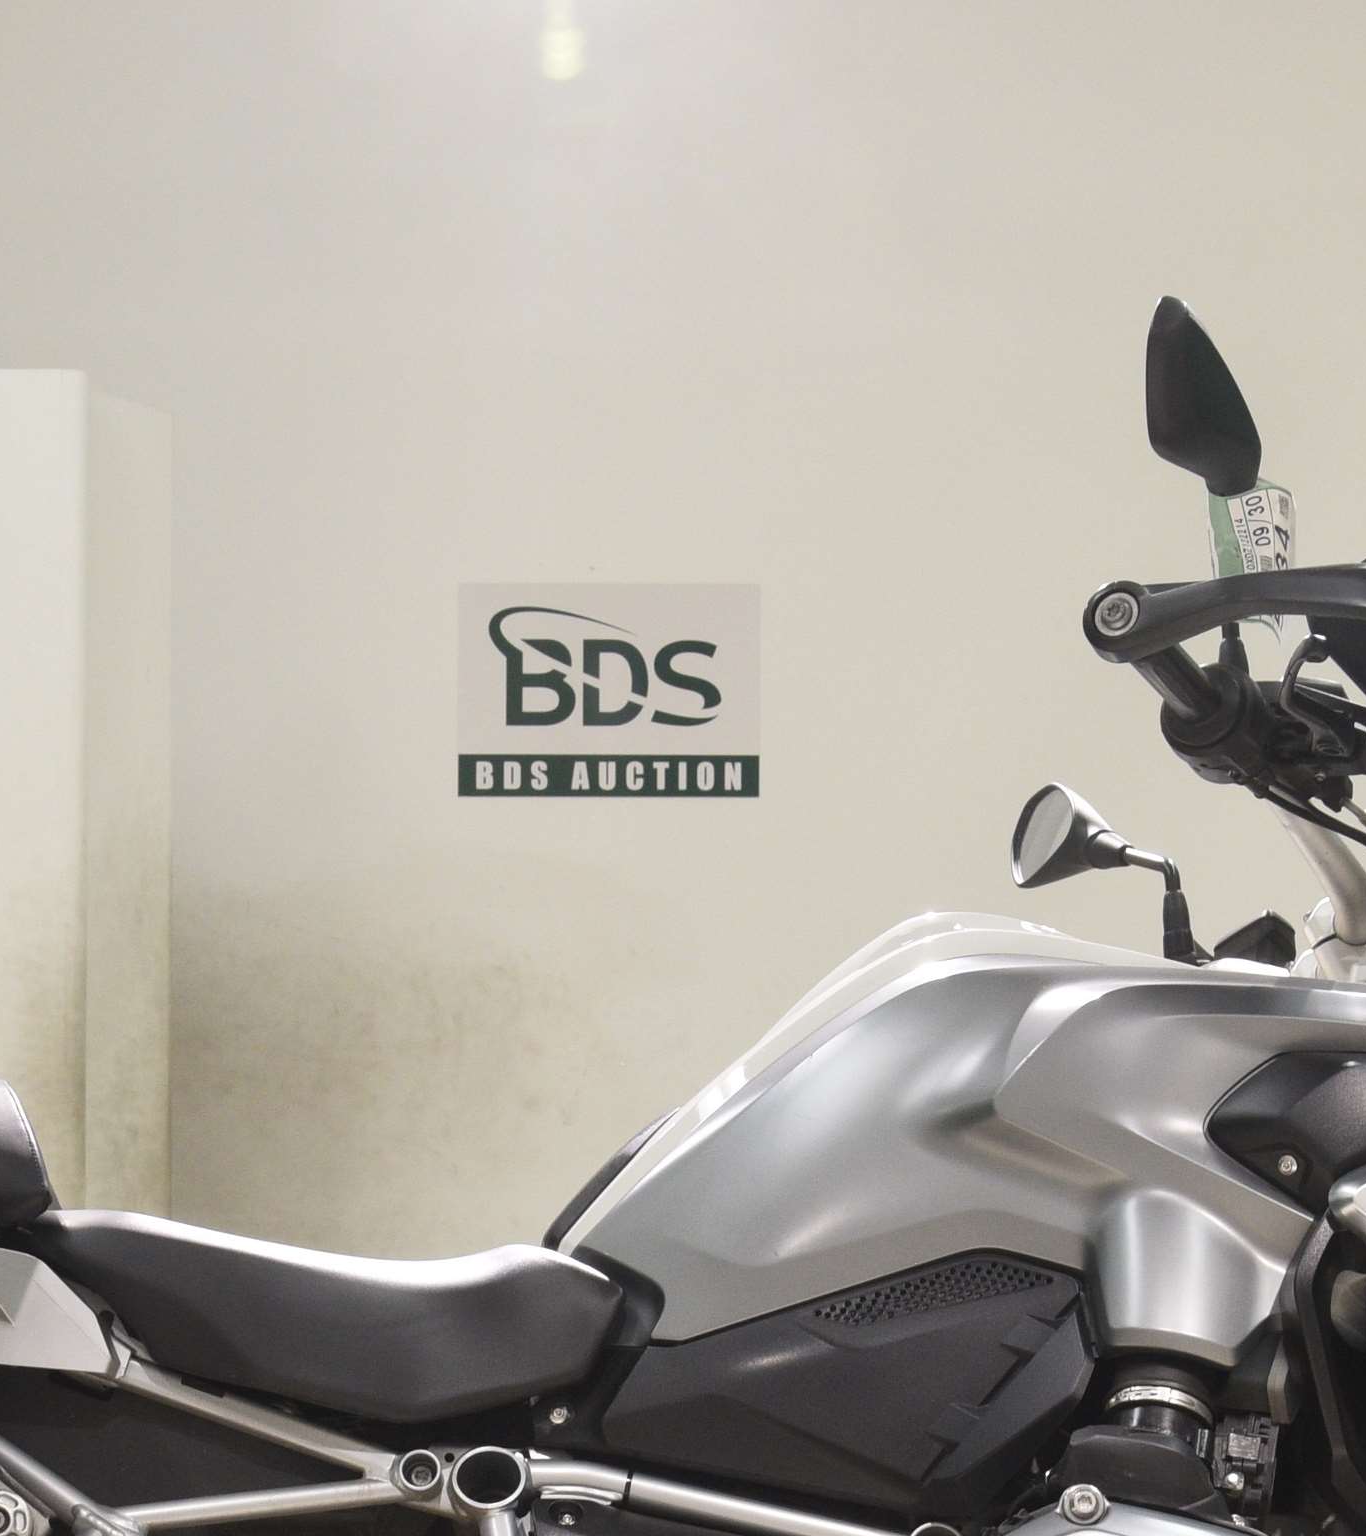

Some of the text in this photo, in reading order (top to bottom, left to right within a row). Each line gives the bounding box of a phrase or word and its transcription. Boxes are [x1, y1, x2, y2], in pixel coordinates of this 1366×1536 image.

[489, 606, 722, 726] BDS
[475, 760, 742, 790] BDS AUCTION
